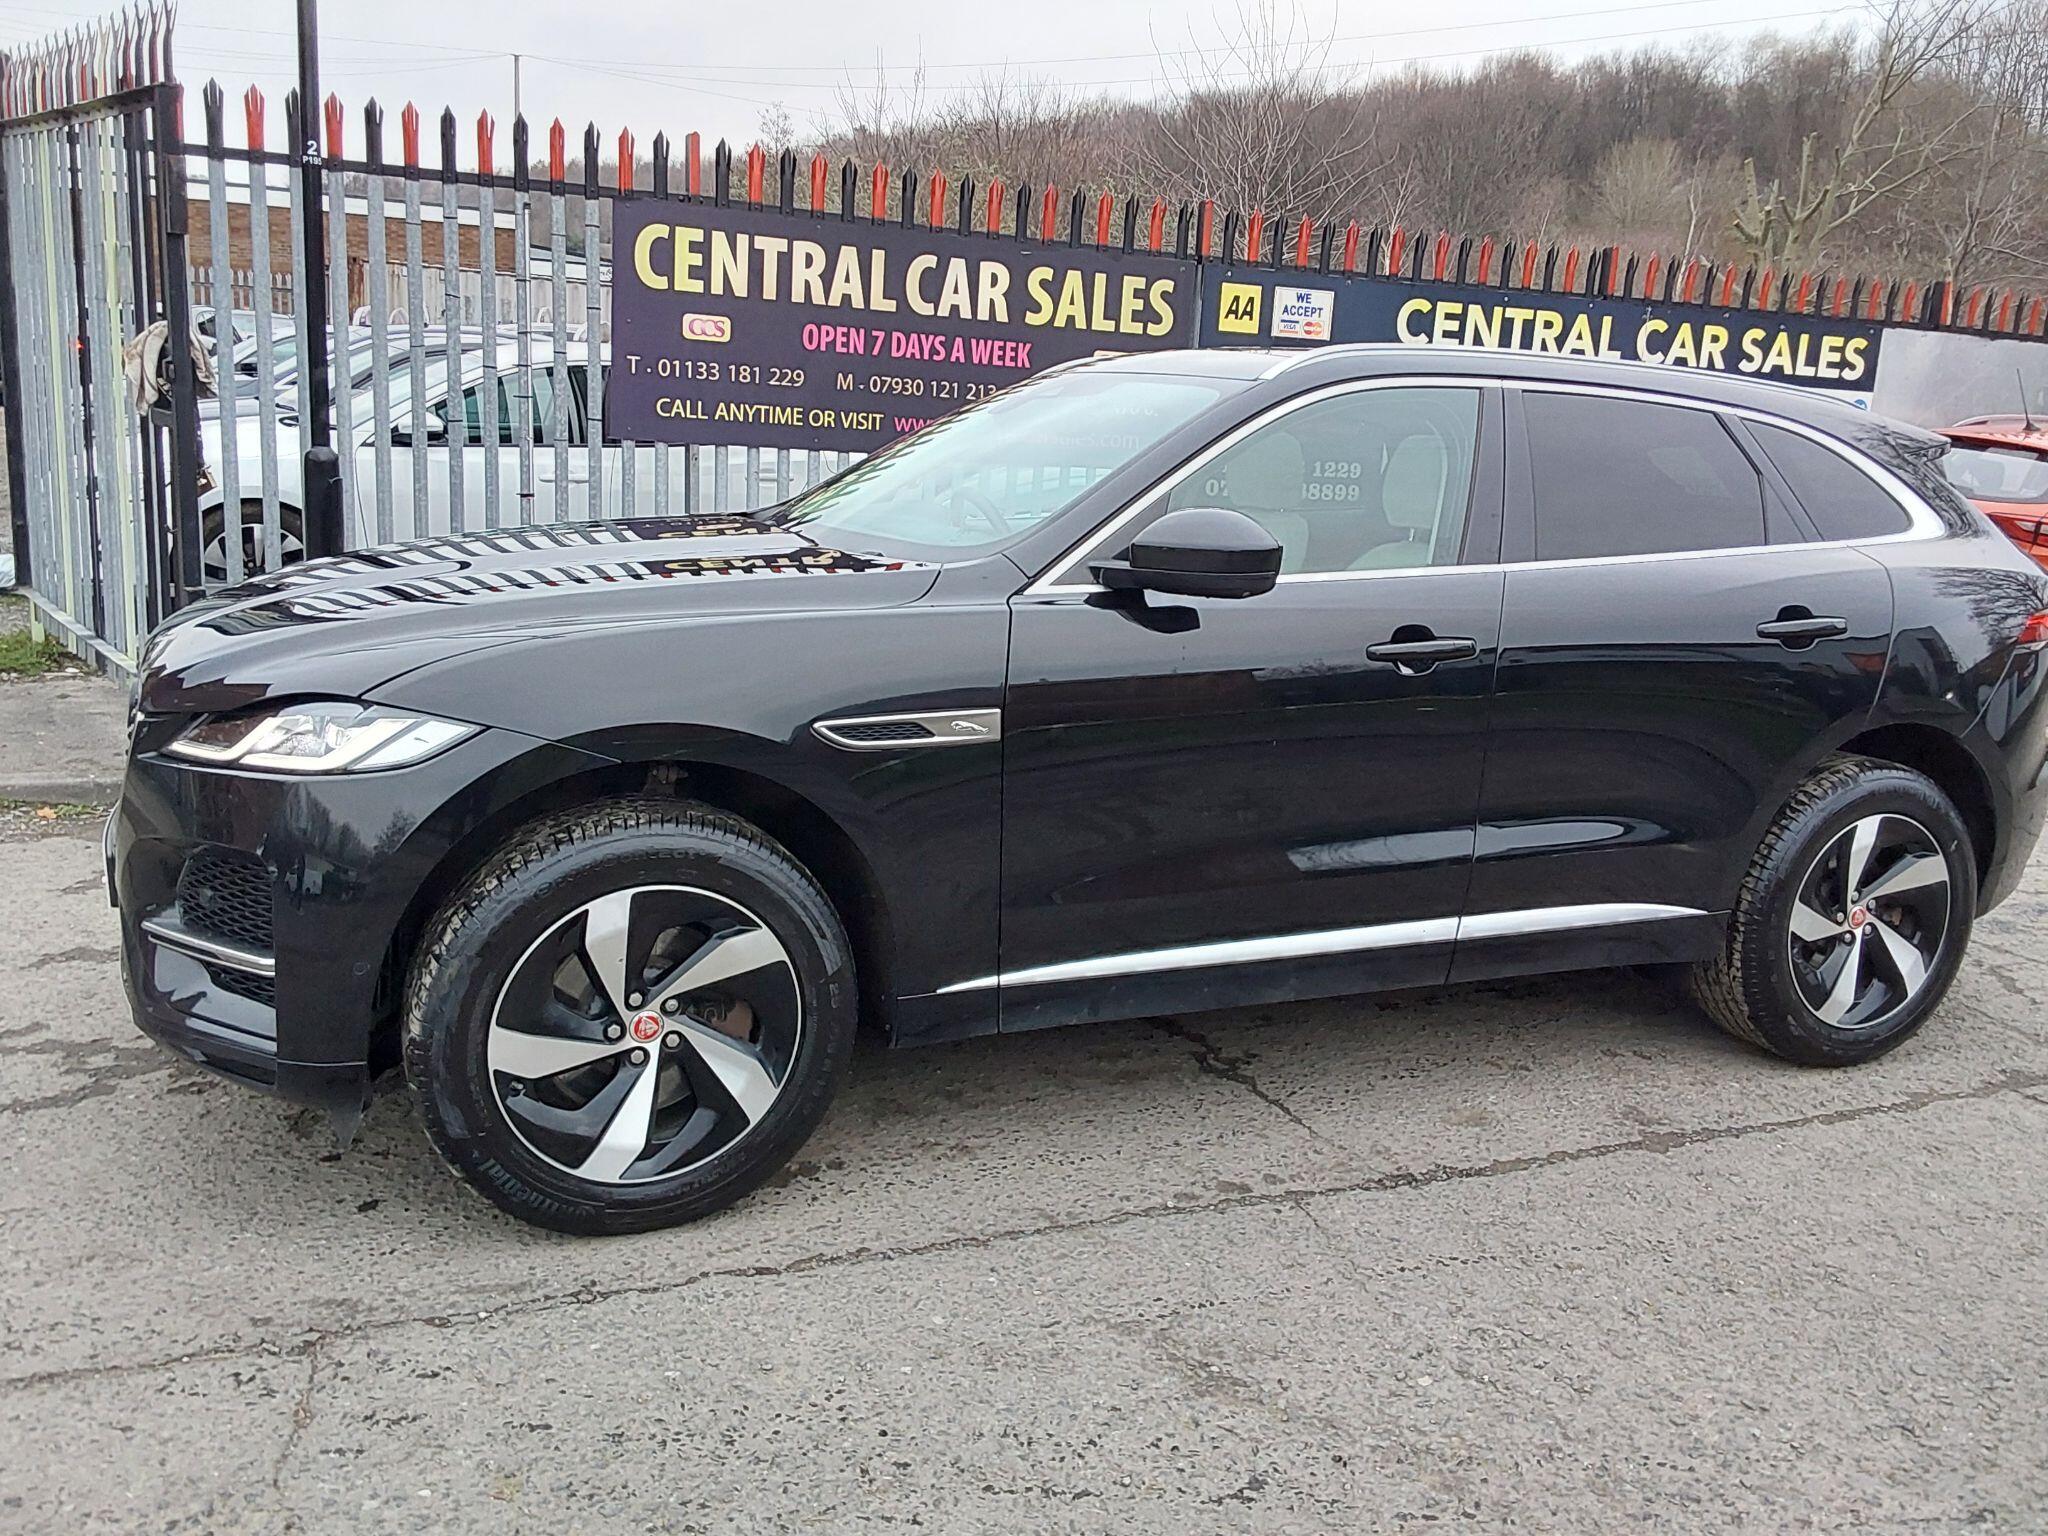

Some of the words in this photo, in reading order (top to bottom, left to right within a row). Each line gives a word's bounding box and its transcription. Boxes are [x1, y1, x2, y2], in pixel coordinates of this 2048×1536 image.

[306, 140, 318, 155] 2
[633, 223, 897, 313] CENTRAL
[905, 254, 1011, 324] CAR
[1025, 266, 1175, 337] SALES
[1224, 294, 1255, 321] AA
[1282, 304, 1324, 318] ACCEPT
[1296, 292, 1312, 304] WE
[688, 318, 726, 338] CCS
[1396, 298, 1622, 359] CENTRAL
[1636, 318, 1729, 369] CAR
[1737, 327, 1869, 382] SALES
[802, 323, 866, 355] OPEN
[871, 330, 885, 356] 7
[891, 331, 946, 362] DAYS
[950, 336, 965, 363] A
[971, 338, 1032, 368] WEEK
[657, 358, 720, 381] 01133
[728, 364, 761, 384] 181
[767, 367, 805, 387] 229
[869, 375, 924, 396] 07930
[930, 380, 959, 399] 121
[656, 397, 709, 420] CALL
[714, 401, 804, 426] ANYTIME
[808, 409, 835, 428] OR
[840, 411, 884, 431] VISIT
